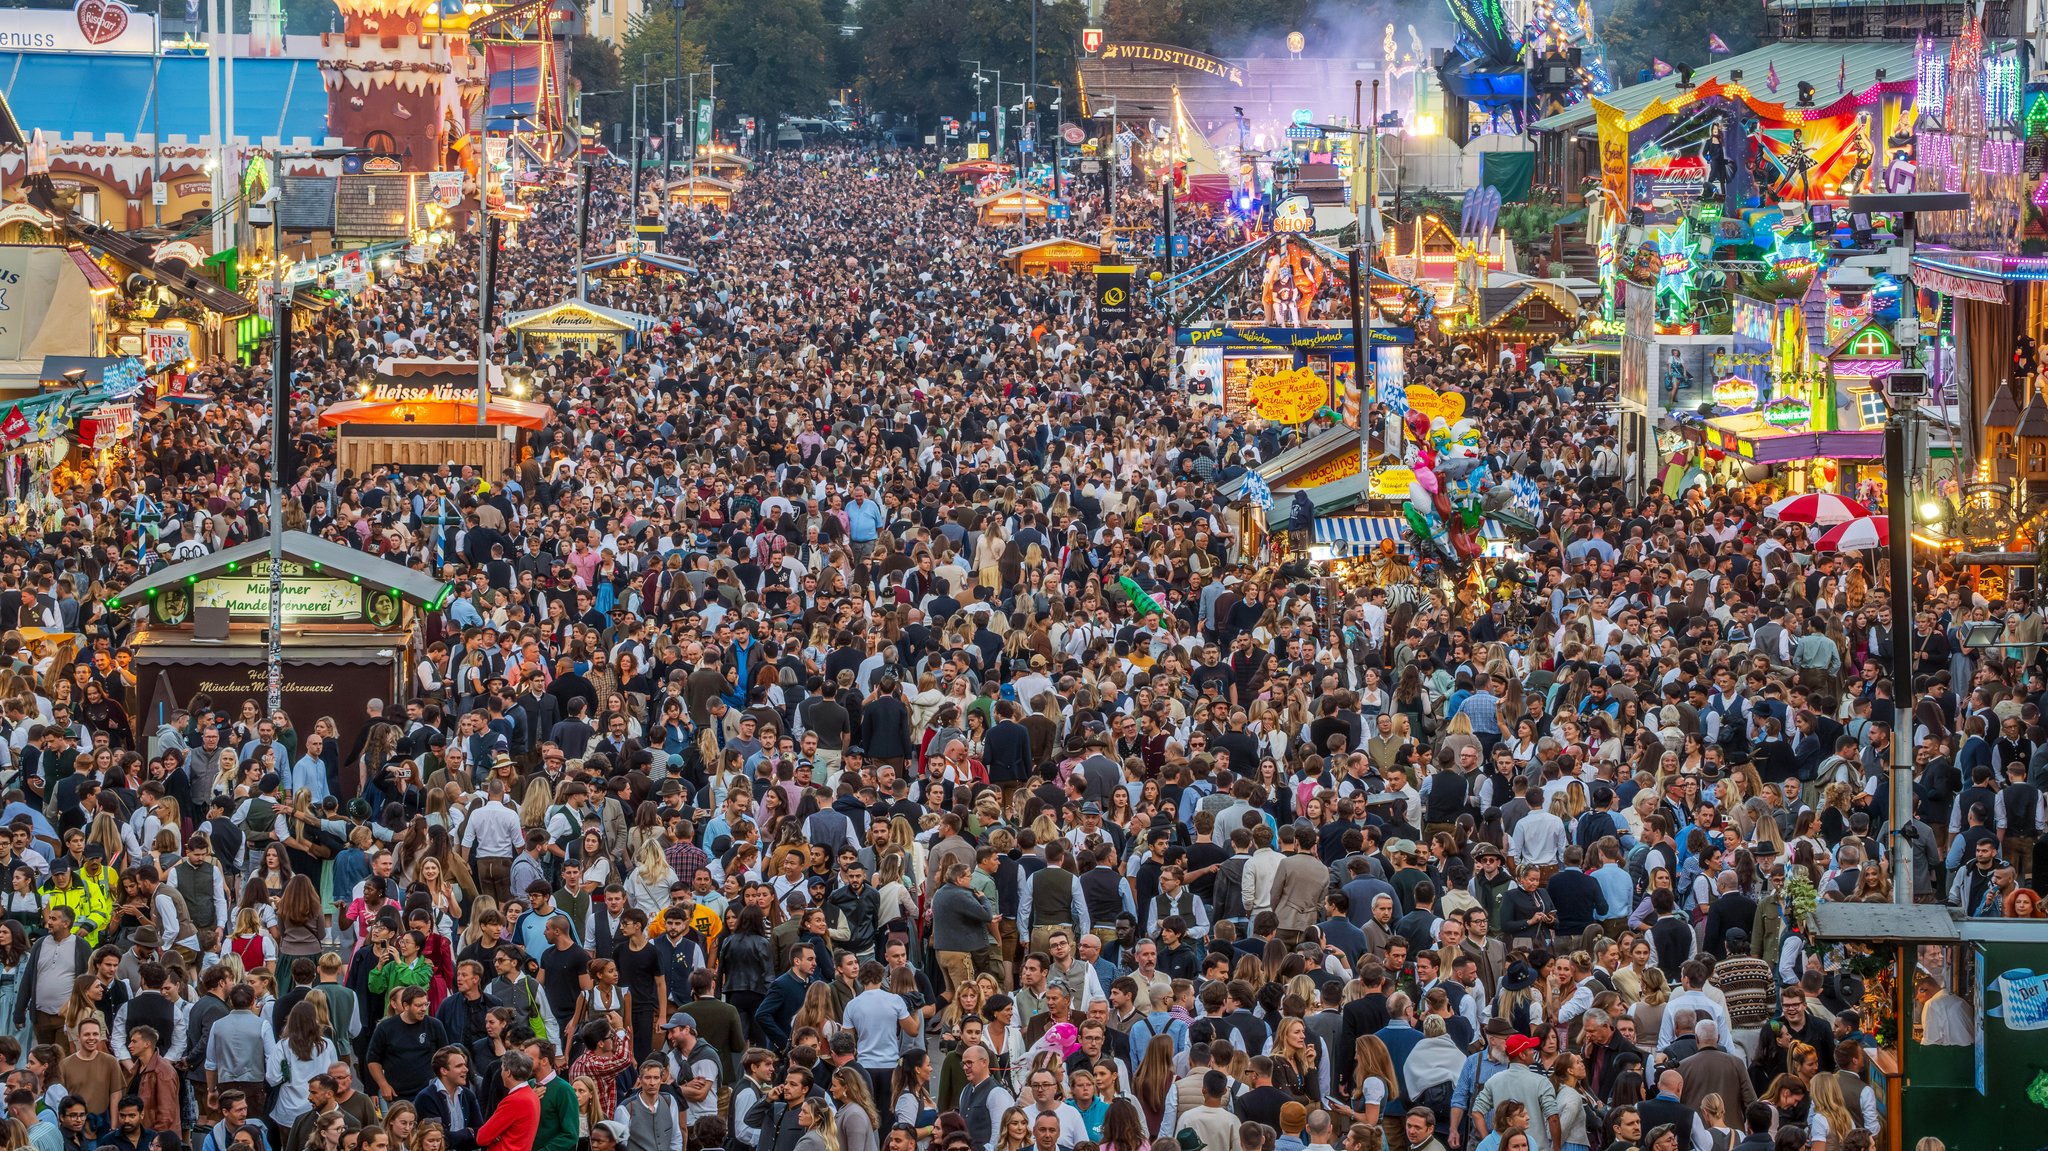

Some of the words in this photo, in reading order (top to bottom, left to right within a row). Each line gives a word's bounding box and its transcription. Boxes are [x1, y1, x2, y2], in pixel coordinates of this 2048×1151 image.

[0, 32, 55, 47] enuss
[1120, 45, 1229, 78] WILDSTUBEN
[1273, 217, 1314, 232] SHOP
[2017, 264, 2048, 274] GLU
[552, 315, 592, 326] Mandeln
[1600, 320, 1626, 336] KASS
[177, 336, 184, 348] &
[556, 335, 589, 343] Mandeln
[1191, 327, 1223, 345] Pins
[1369, 329, 1397, 342] Tassen
[374, 384, 428, 401] Heisse
[431, 383, 479, 401] Nüsse
[247, 583, 311, 595] Münhner
[200, 681, 250, 693] Münchner
[2019, 984, 2039, 1001] Der
